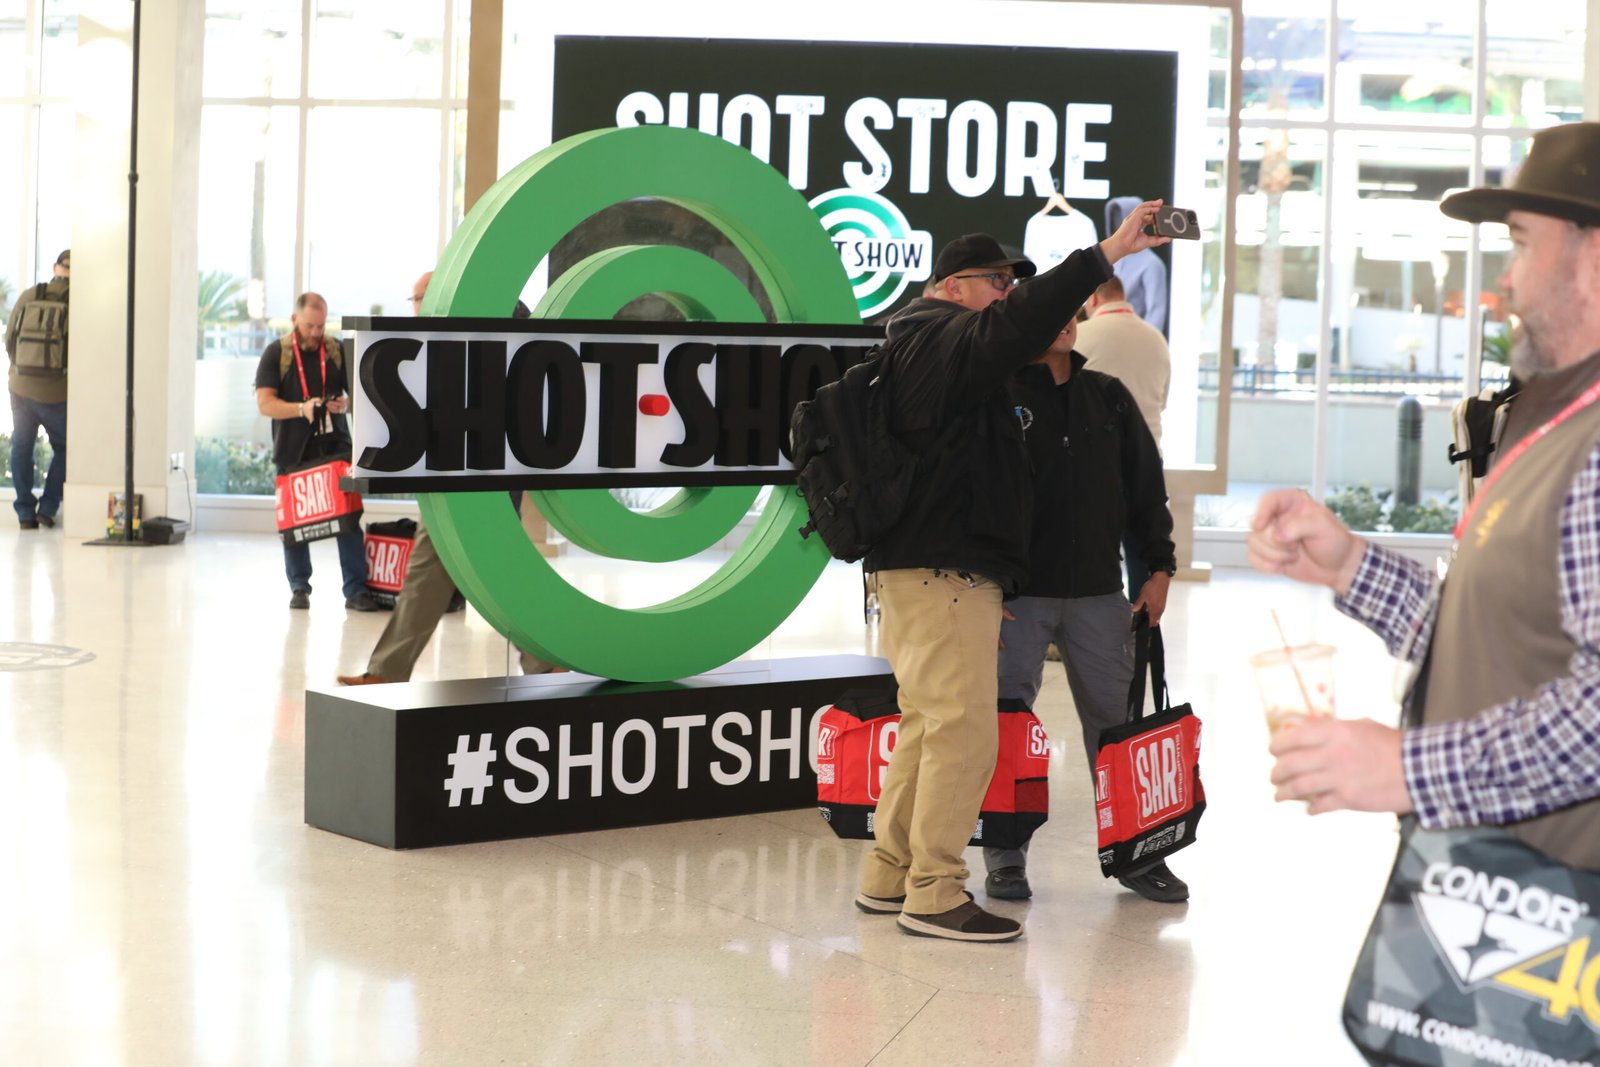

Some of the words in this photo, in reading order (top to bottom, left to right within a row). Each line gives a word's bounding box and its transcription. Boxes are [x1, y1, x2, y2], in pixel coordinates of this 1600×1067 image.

[842, 96, 1113, 200] STORE
[853, 242, 924, 269] SHOW
[357, 337, 660, 471] SHOT
[660, 341, 880, 468] SHO
[443, 703, 835, 808] #SHOTSH
[1136, 737, 1178, 818] SAR
[1422, 861, 1582, 938] CONDOR
